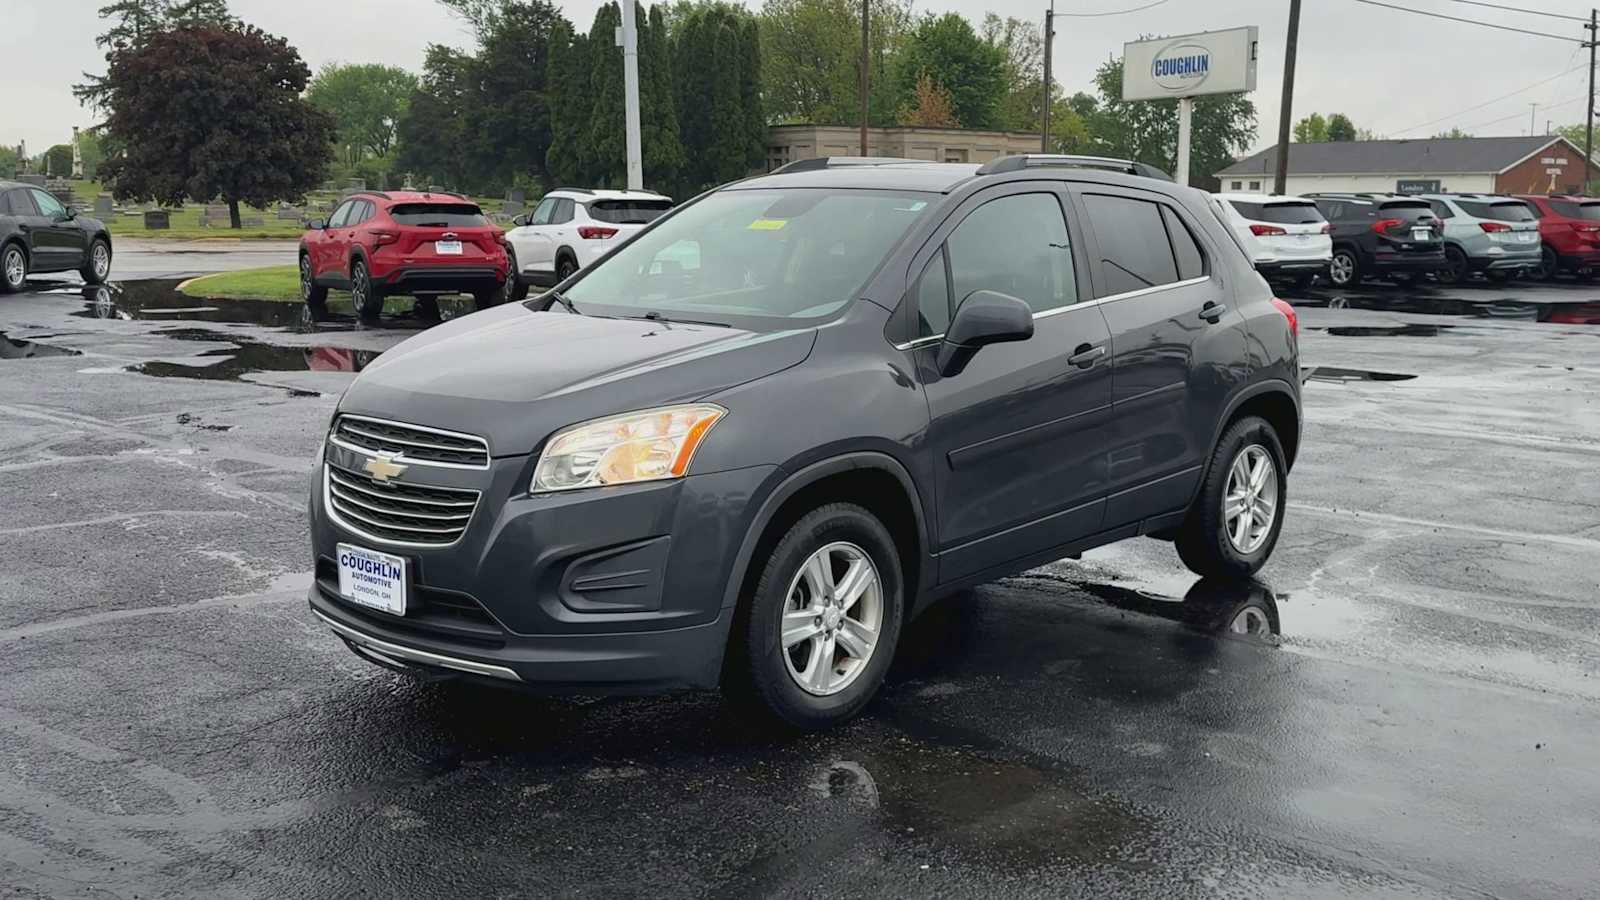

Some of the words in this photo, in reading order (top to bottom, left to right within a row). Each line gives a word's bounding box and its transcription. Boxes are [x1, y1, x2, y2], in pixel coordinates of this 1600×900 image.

[1155, 54, 1209, 77] COUGHLIN
[341, 554, 401, 581] COUGHLIN
[352, 571, 392, 589] AUTOMOTIVE
[381, 591, 391, 600] OH
